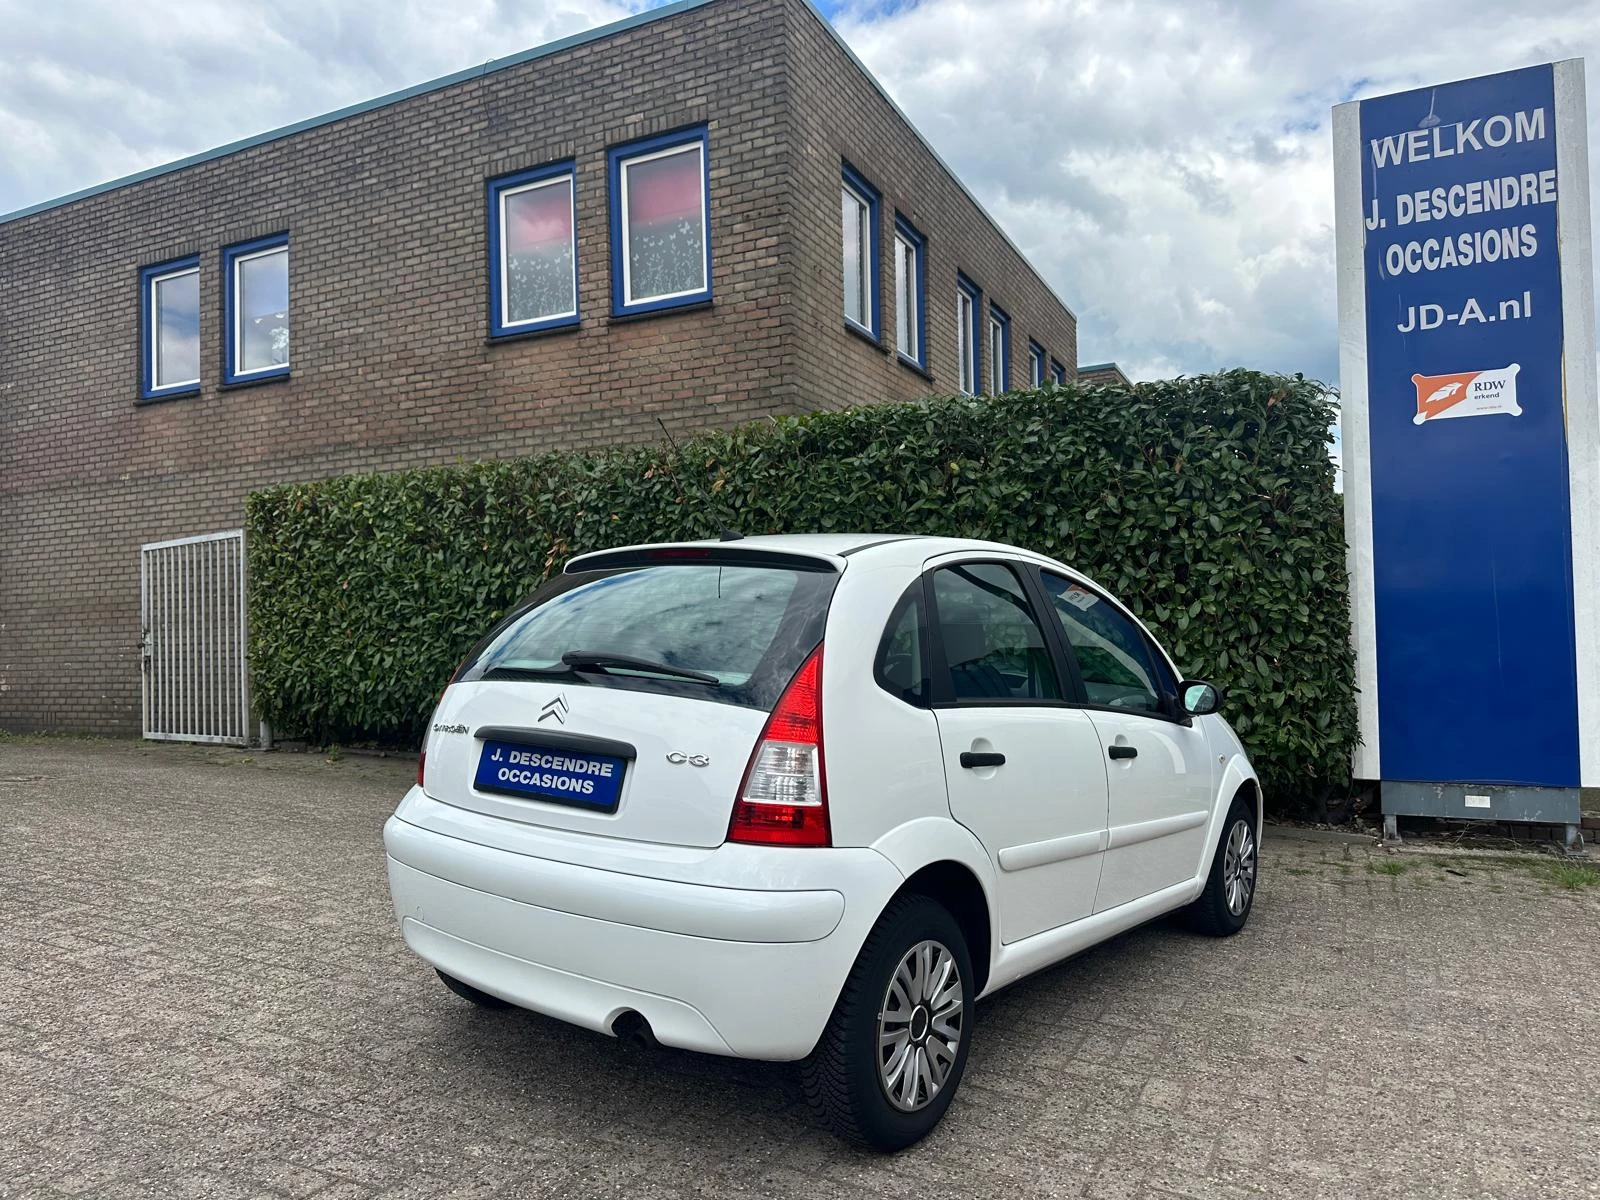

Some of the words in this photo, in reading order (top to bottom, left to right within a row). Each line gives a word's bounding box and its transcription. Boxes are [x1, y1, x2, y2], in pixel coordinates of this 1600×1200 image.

[1371, 107, 1546, 169] WELKOM
[1365, 199, 1386, 231] J.
[1396, 169, 1557, 226] DESCENDRE
[1386, 223, 1538, 276] OCCASIONS
[1397, 290, 1532, 333] JD-A.nl
[1474, 380, 1506, 391] RDW
[1474, 392, 1500, 400] erkend
[491, 748, 503, 762] J.
[509, 750, 614, 778] DESCENDRE
[665, 750, 710, 768] C3
[498, 767, 595, 795] OCCASIONS
